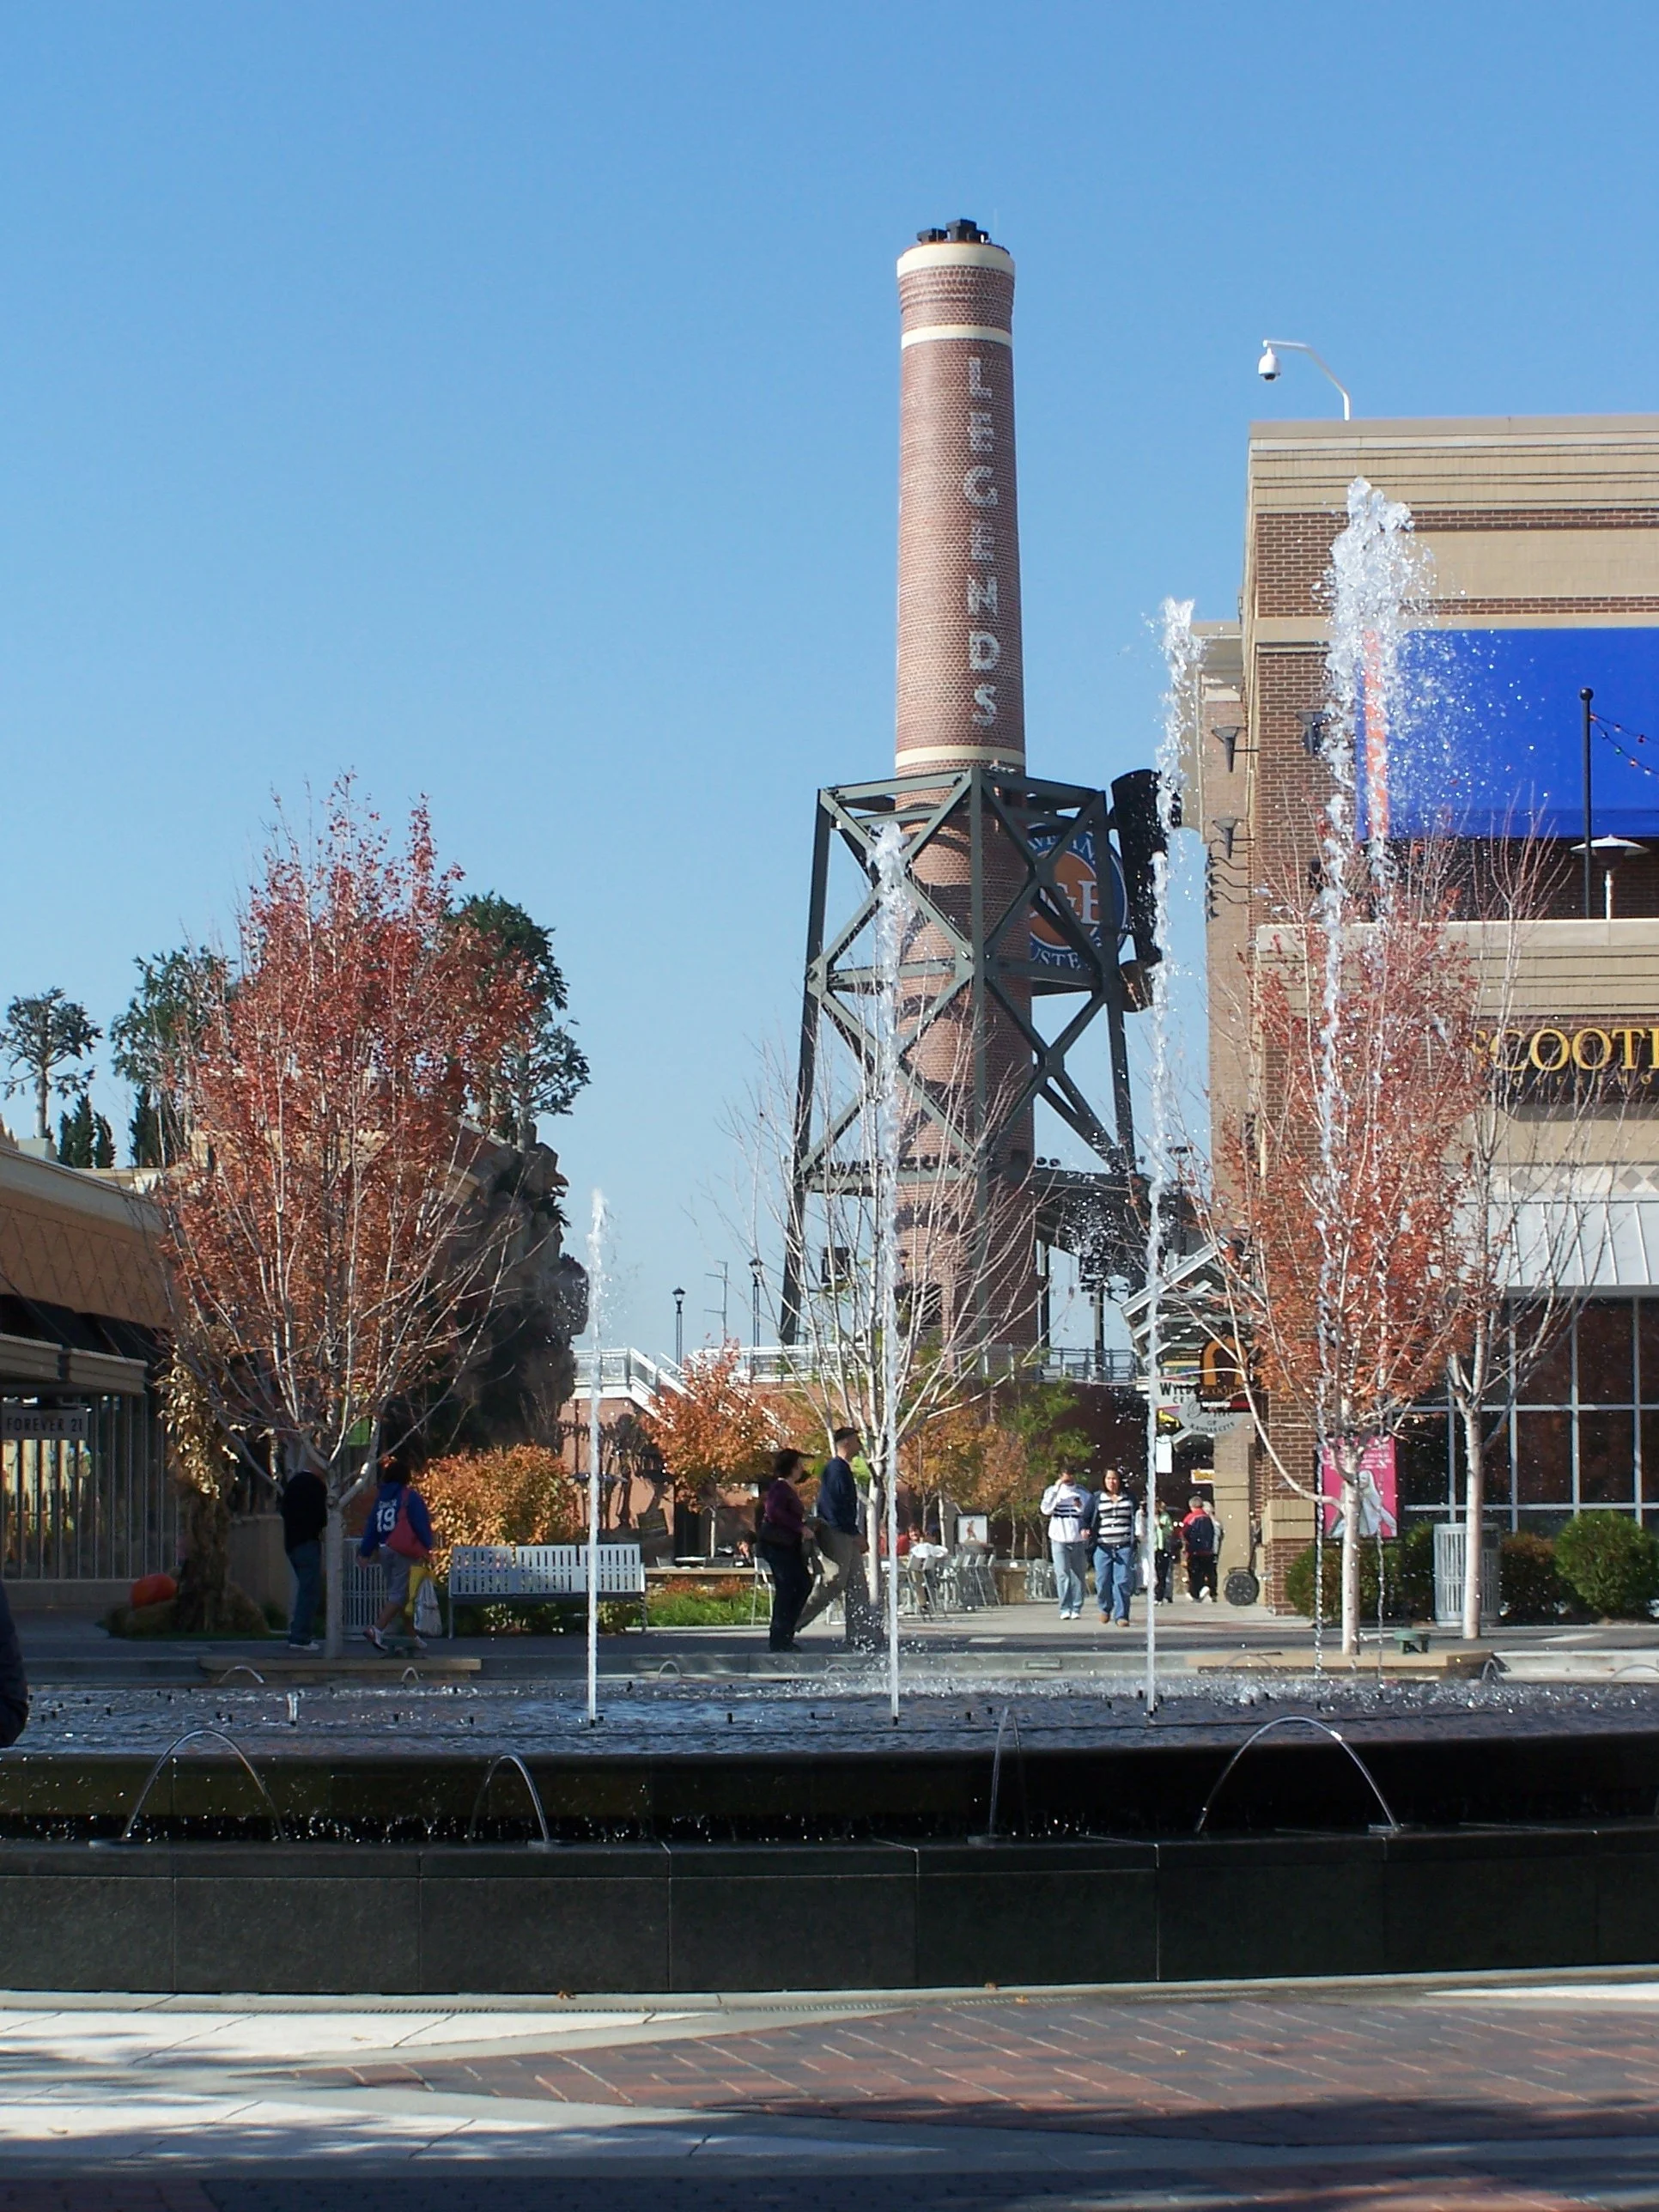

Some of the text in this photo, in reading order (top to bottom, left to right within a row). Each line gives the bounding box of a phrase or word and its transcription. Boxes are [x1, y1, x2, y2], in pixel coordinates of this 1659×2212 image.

[963, 356, 1000, 727] LEGENDS
[7, 1417, 82, 1432] FOREVER 21
[377, 1507, 396, 1532] 19
